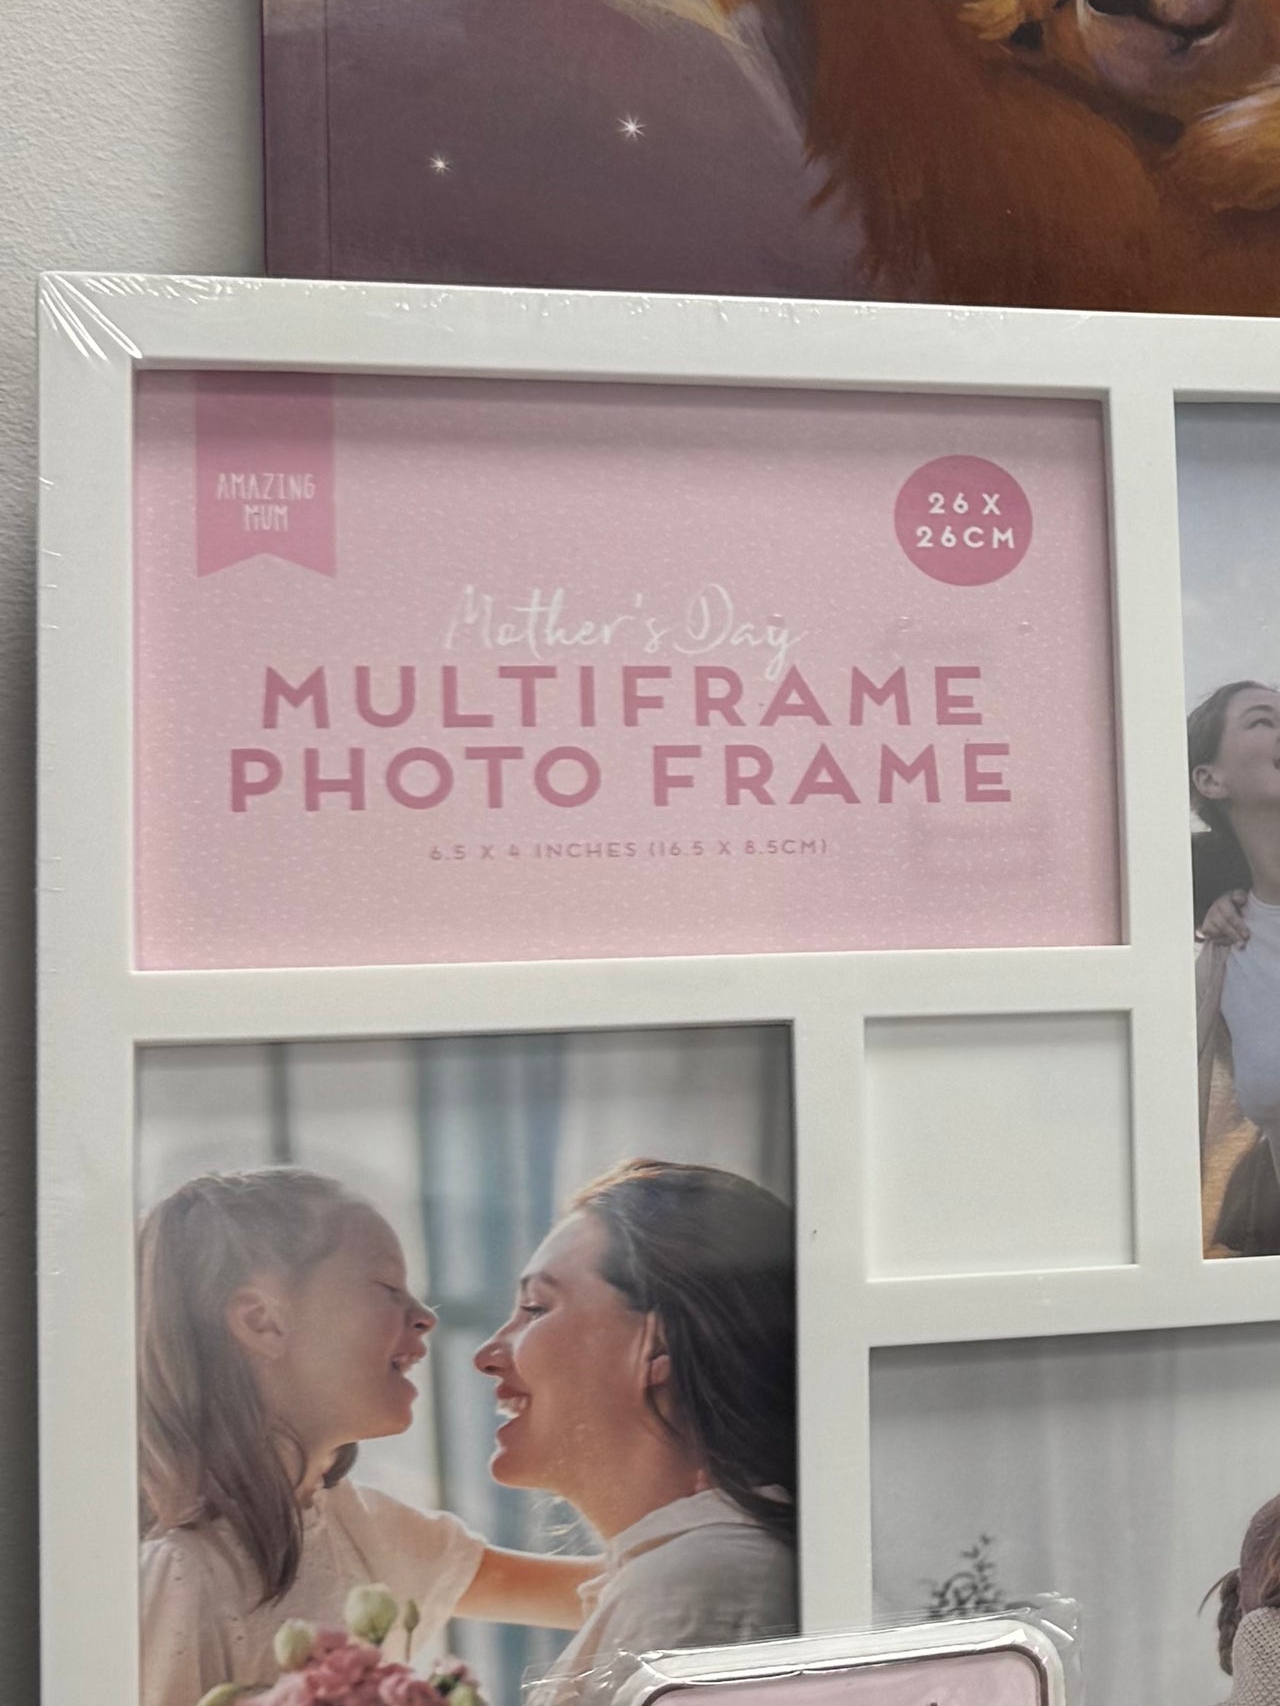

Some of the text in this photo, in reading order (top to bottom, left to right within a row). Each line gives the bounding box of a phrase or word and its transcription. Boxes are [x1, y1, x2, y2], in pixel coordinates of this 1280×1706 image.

[216, 472, 316, 500] AMAZING
[244, 504, 288, 531] MUM
[927, 492, 1003, 516] 26 X
[915, 524, 1016, 550] 26CM
[446, 583, 804, 681] Mother's Day
[262, 665, 983, 729] MULTIFRAME
[230, 741, 1012, 813] PHOTO FRAME
[429, 845, 465, 860] 6.5
[480, 845, 495, 860] X
[536, 842, 637, 859] INCHES
[718, 840, 731, 855] X
